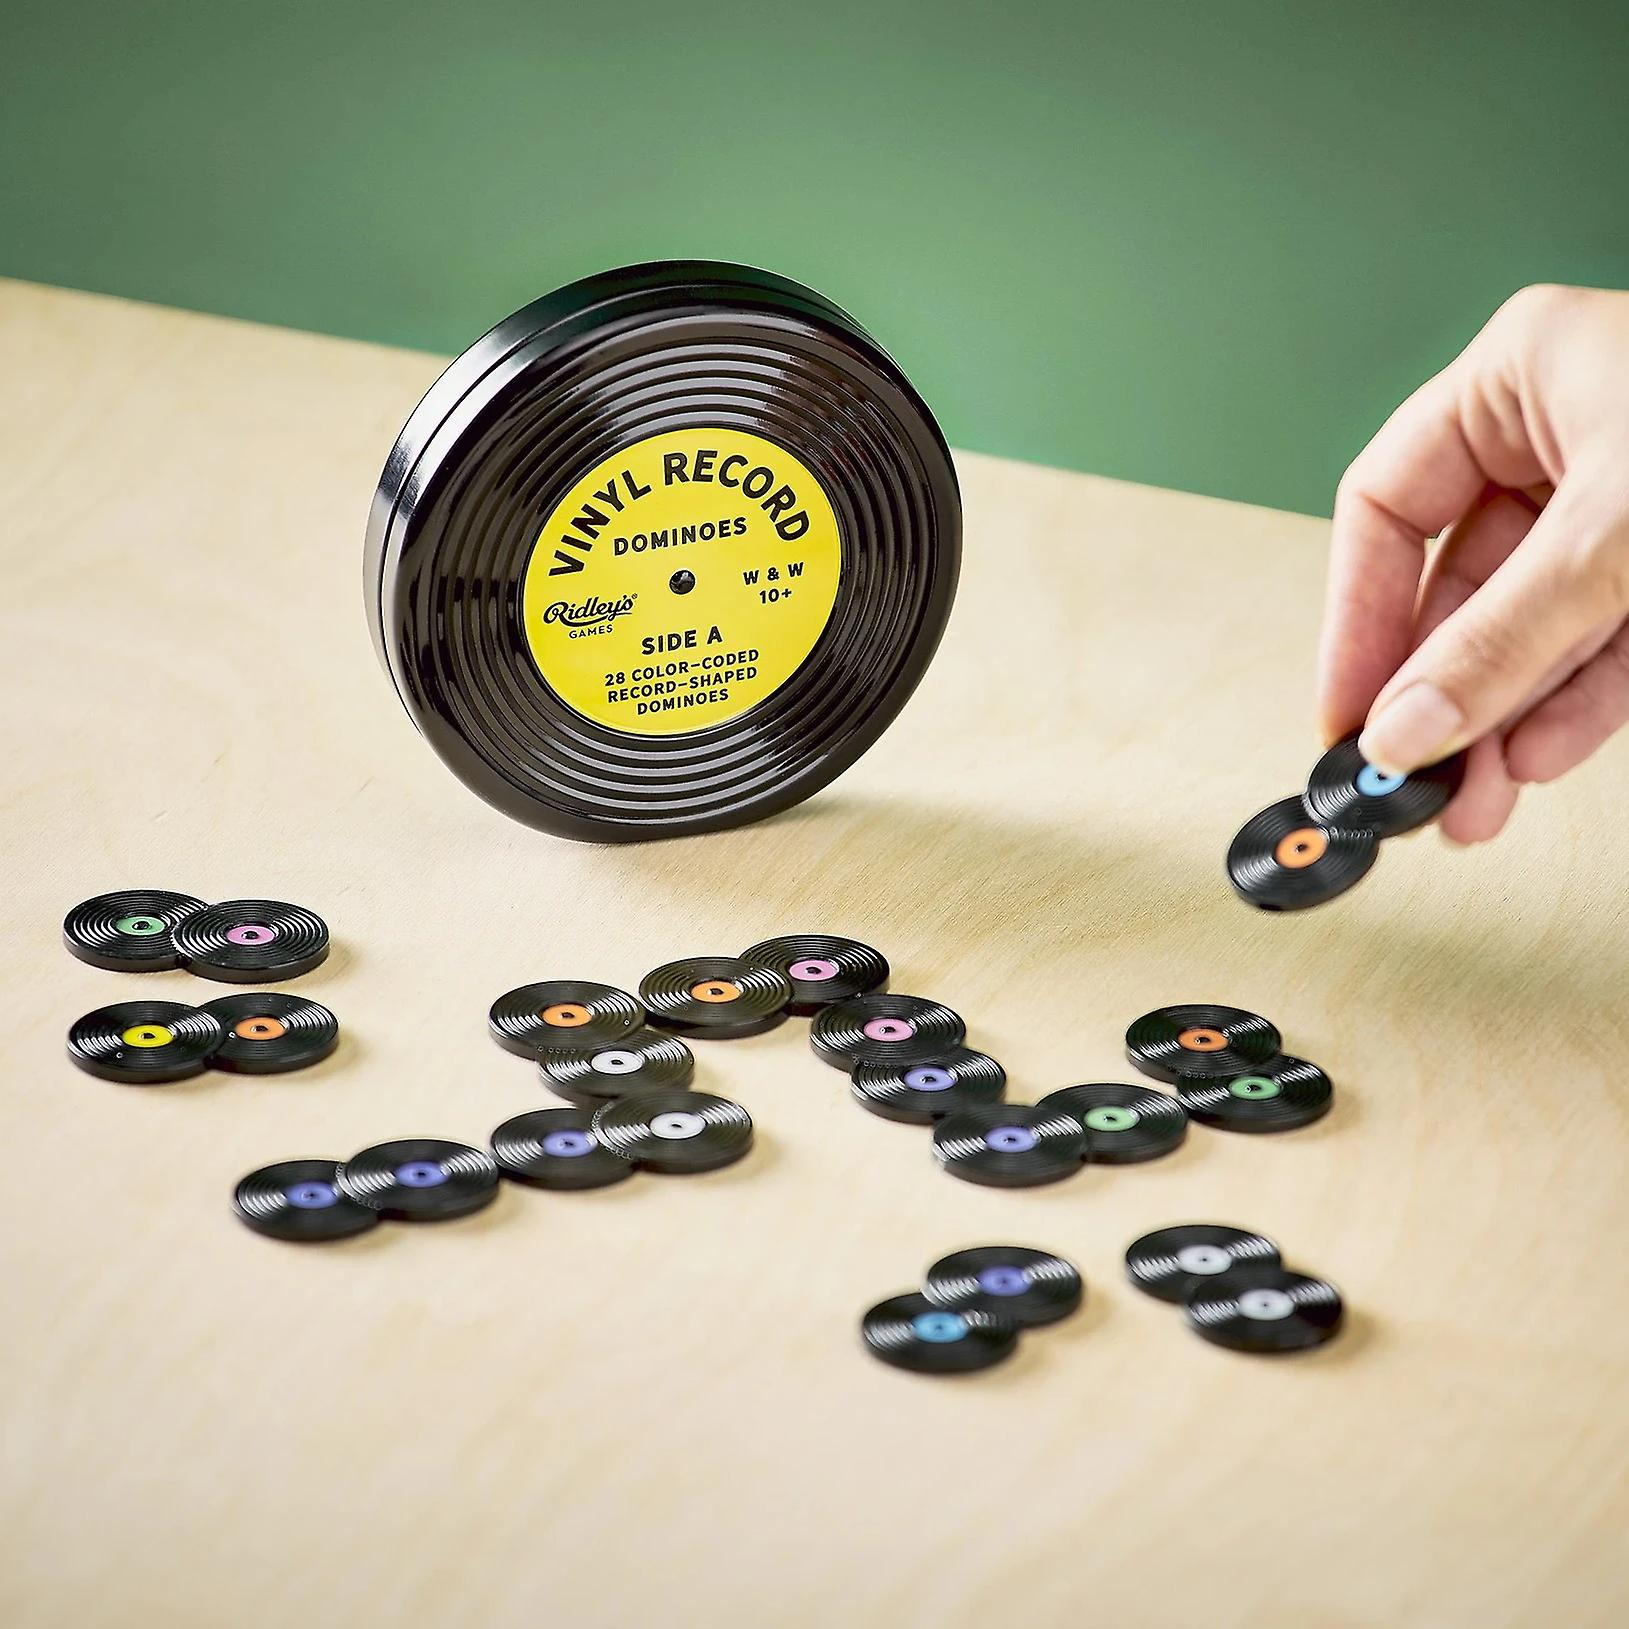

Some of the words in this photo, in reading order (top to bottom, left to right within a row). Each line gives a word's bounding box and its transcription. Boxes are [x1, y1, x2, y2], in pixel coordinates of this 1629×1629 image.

[549, 470, 651, 576] VINYL
[663, 450, 810, 541] RECORD
[613, 517, 747, 556] DOMINOES
[743, 570, 759, 585] W
[767, 567, 779, 580] &
[788, 562, 804, 577] W
[759, 589, 792, 604] 10+
[568, 624, 613, 639] GAMES
[641, 630, 697, 655] SIDE
[707, 626, 723, 644] A
[604, 672, 626, 687] 28
[637, 689, 729, 715] DOMINOES
